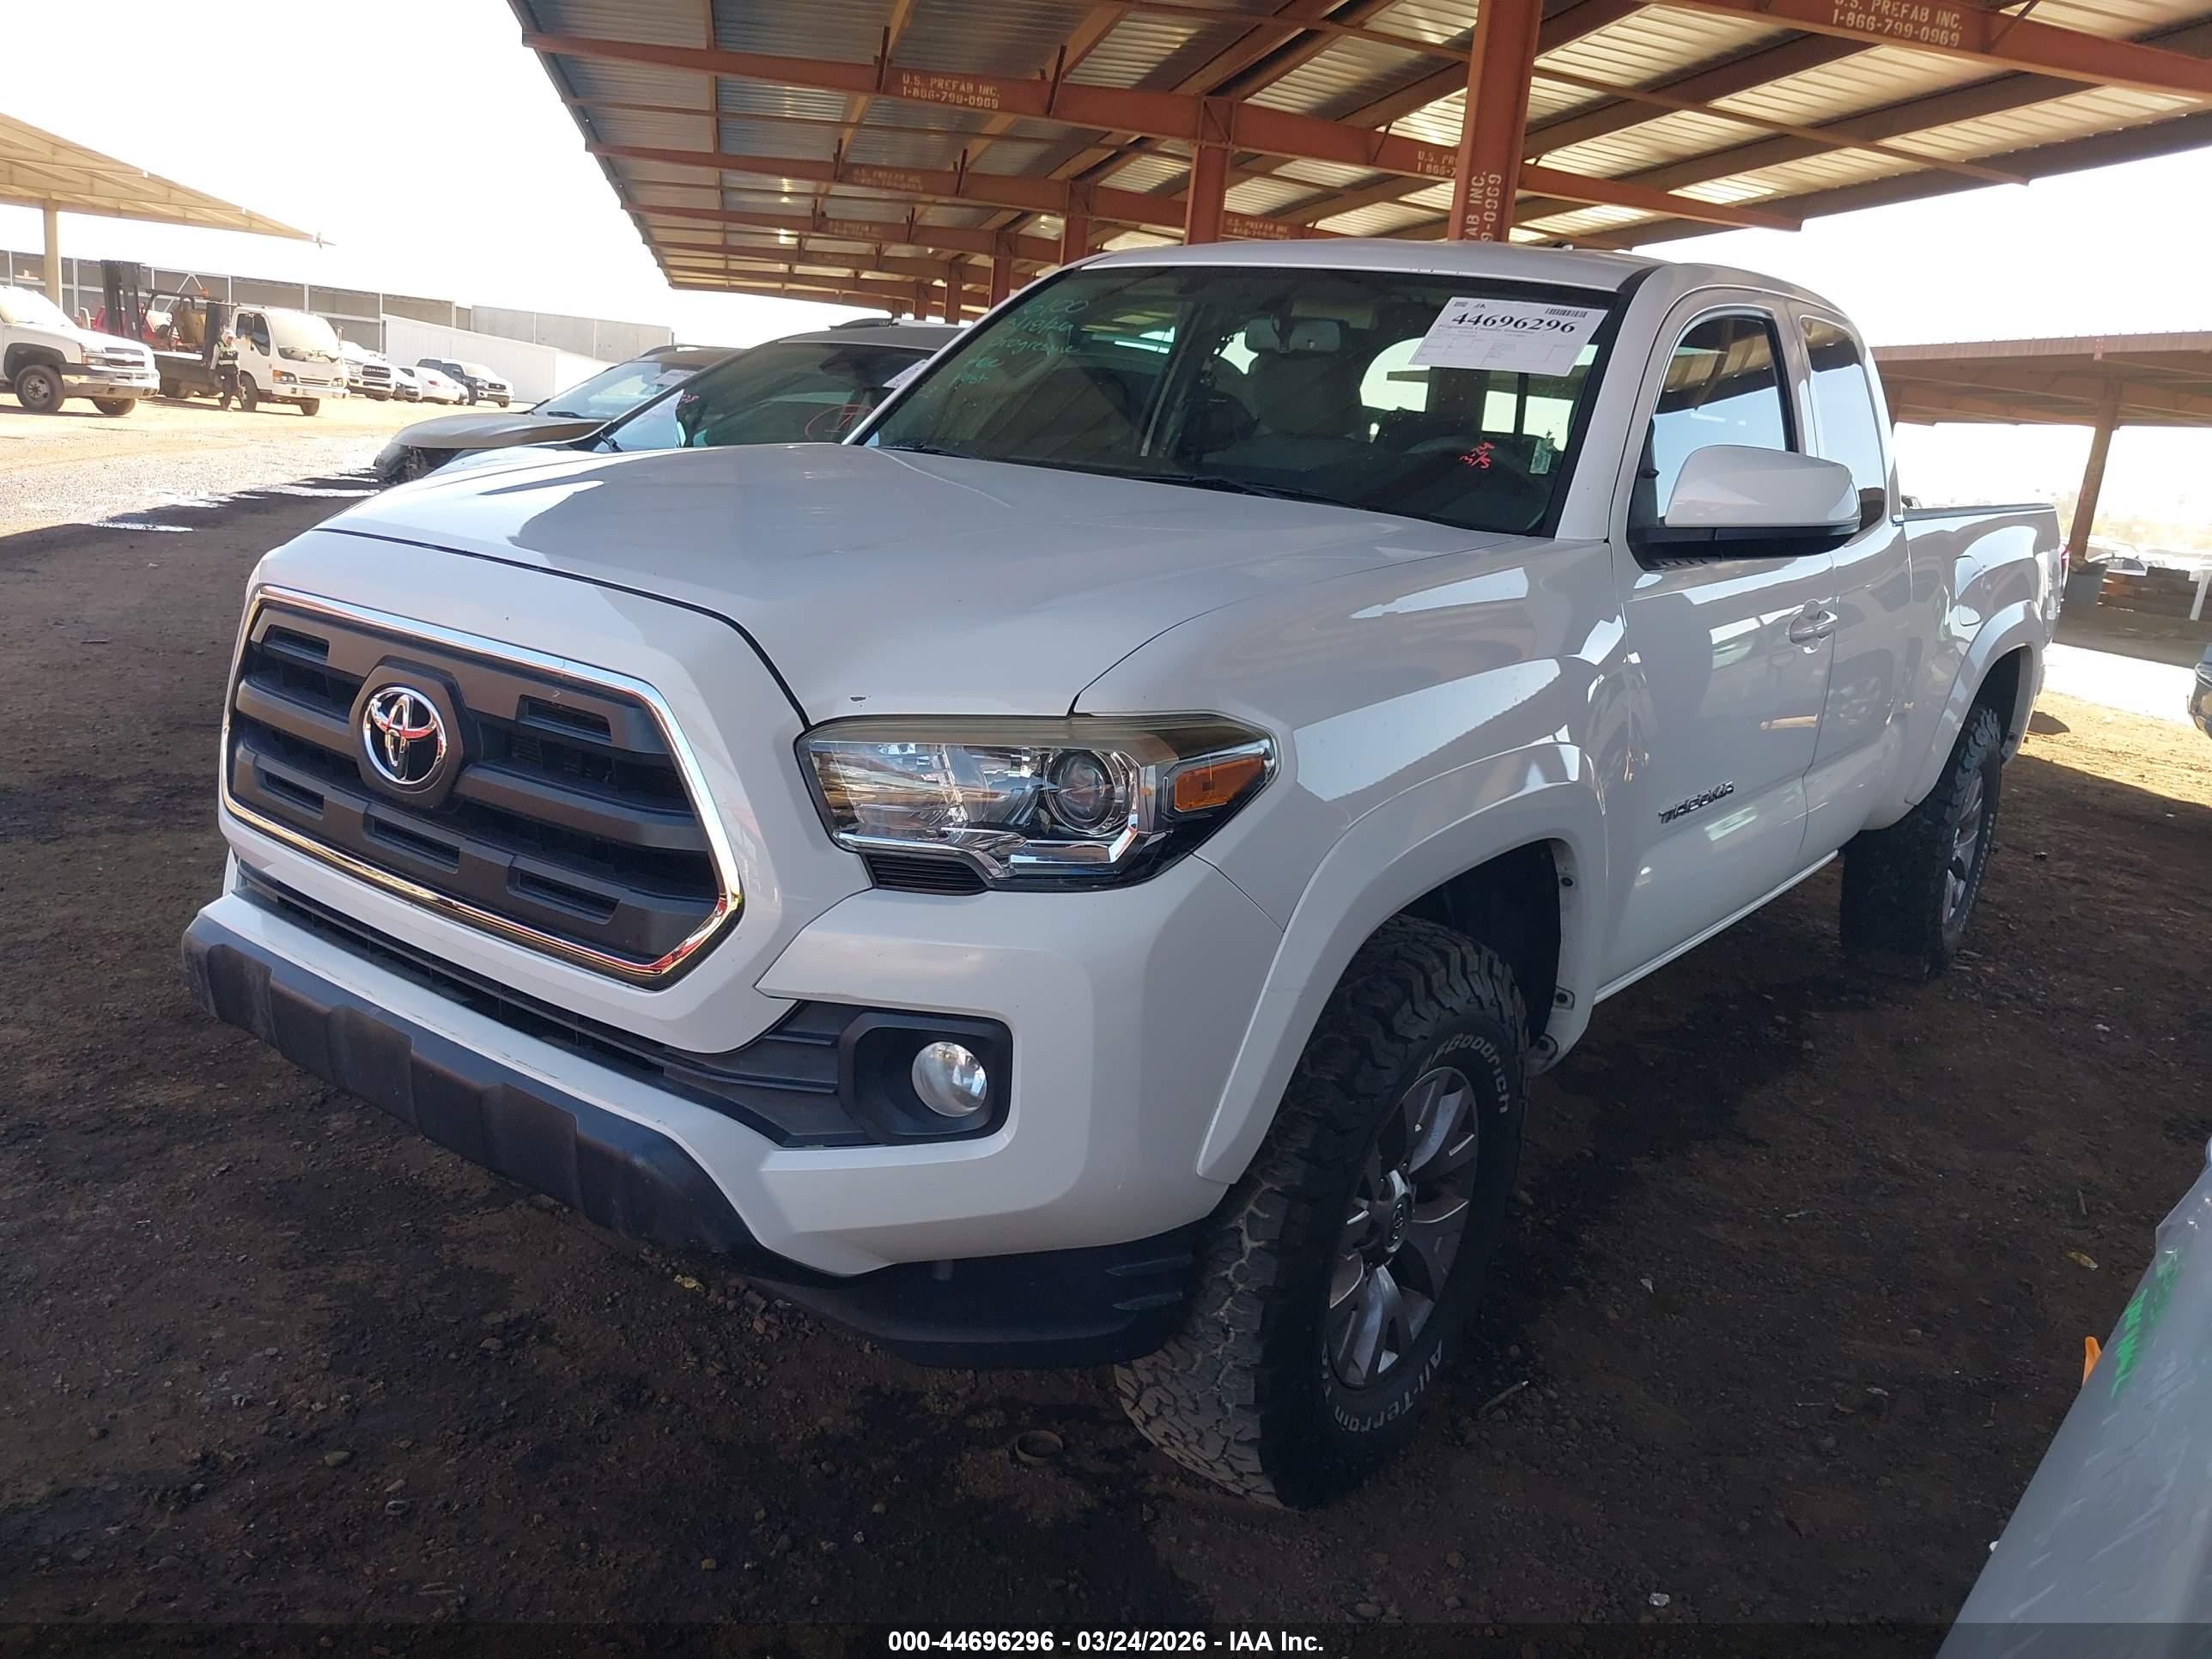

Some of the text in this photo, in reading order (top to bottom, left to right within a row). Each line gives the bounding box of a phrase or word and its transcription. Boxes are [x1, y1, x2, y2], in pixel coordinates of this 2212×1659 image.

[1832, 9, 1960, 47] 1-866-799-0969
[1871, 0, 1929, 22] PREFAB
[1936, 10, 1963, 30] INC.
[902, 73, 1000, 97] U.S. PREFAB INC.
[1417, 150, 1457, 166] U.S. PR
[1463, 172, 1486, 240] AB INC.
[1451, 311, 1577, 334] 44696296
